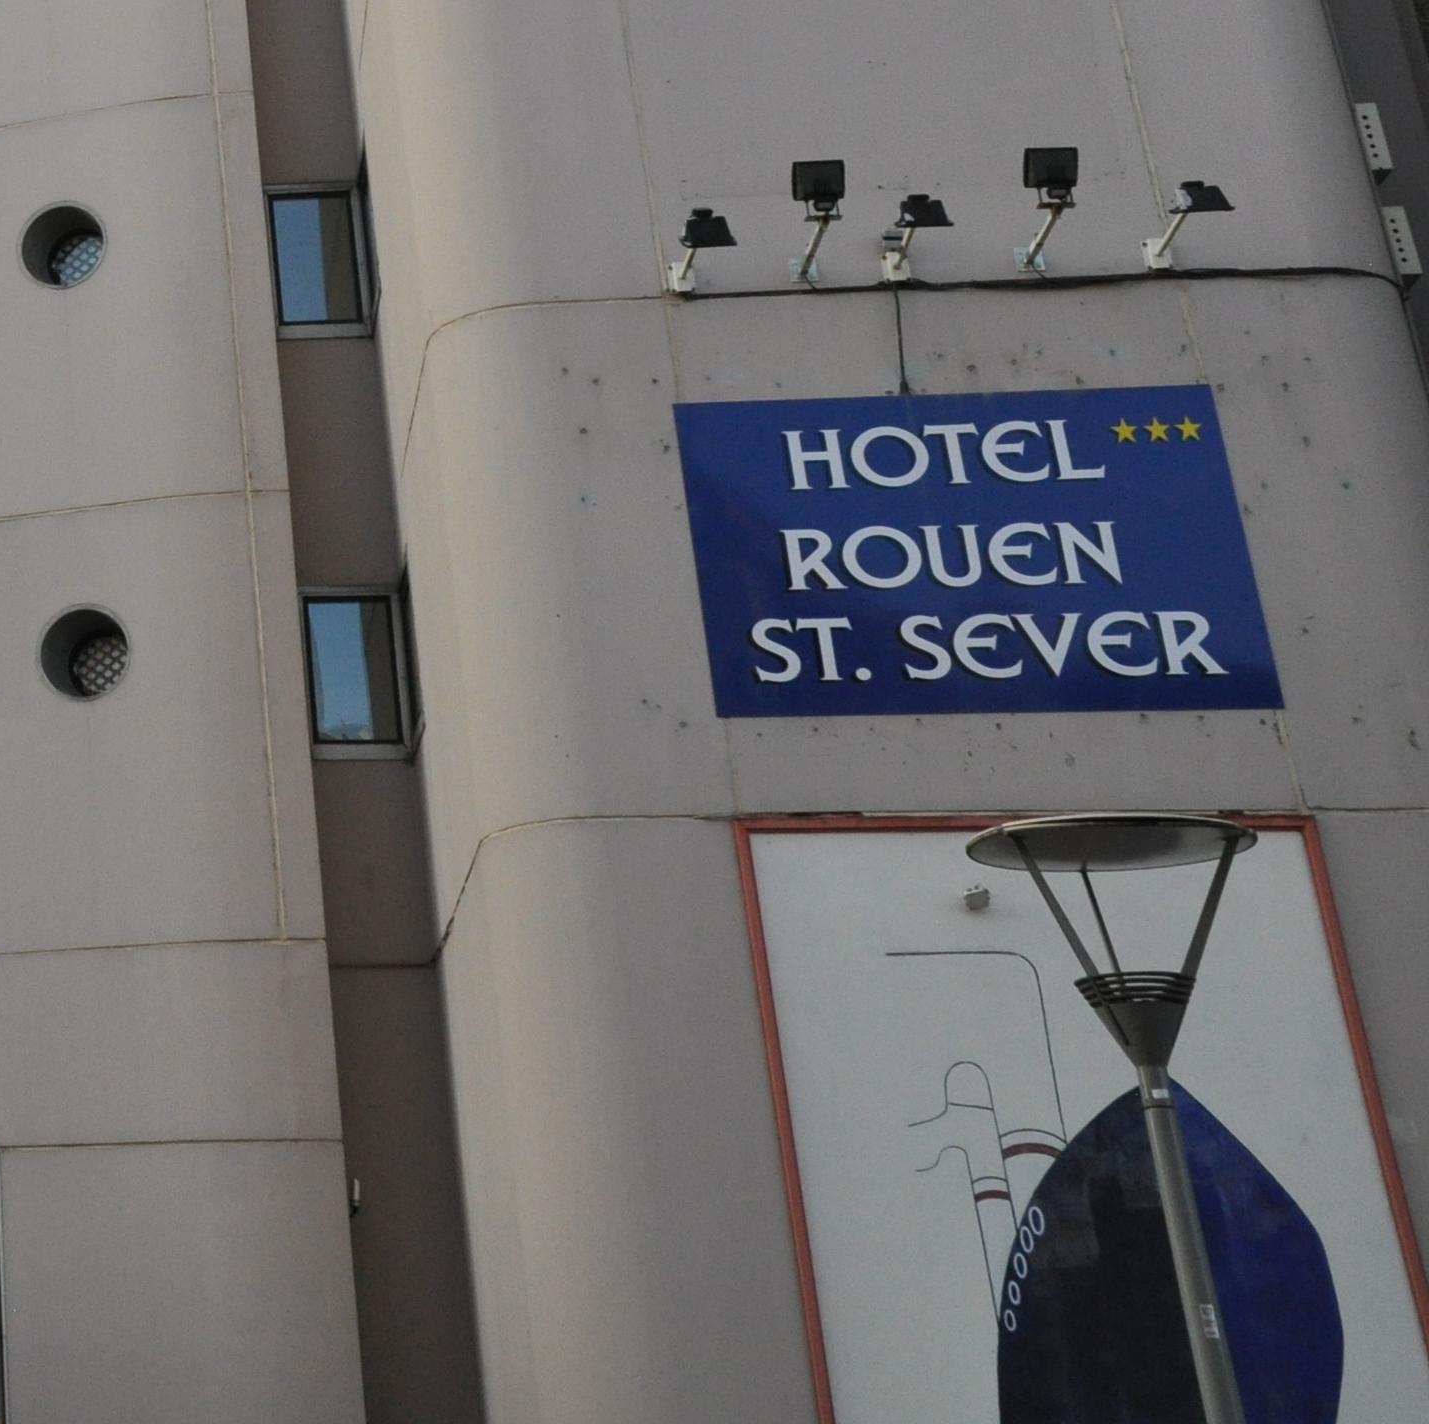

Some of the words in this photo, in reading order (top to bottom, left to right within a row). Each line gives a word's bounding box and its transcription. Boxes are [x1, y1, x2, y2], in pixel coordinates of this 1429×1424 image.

[781, 419, 1106, 490] HOTEL
[780, 520, 1123, 591] ROUEN
[751, 616, 872, 683] ST.
[900, 610, 1230, 680] SEVER
